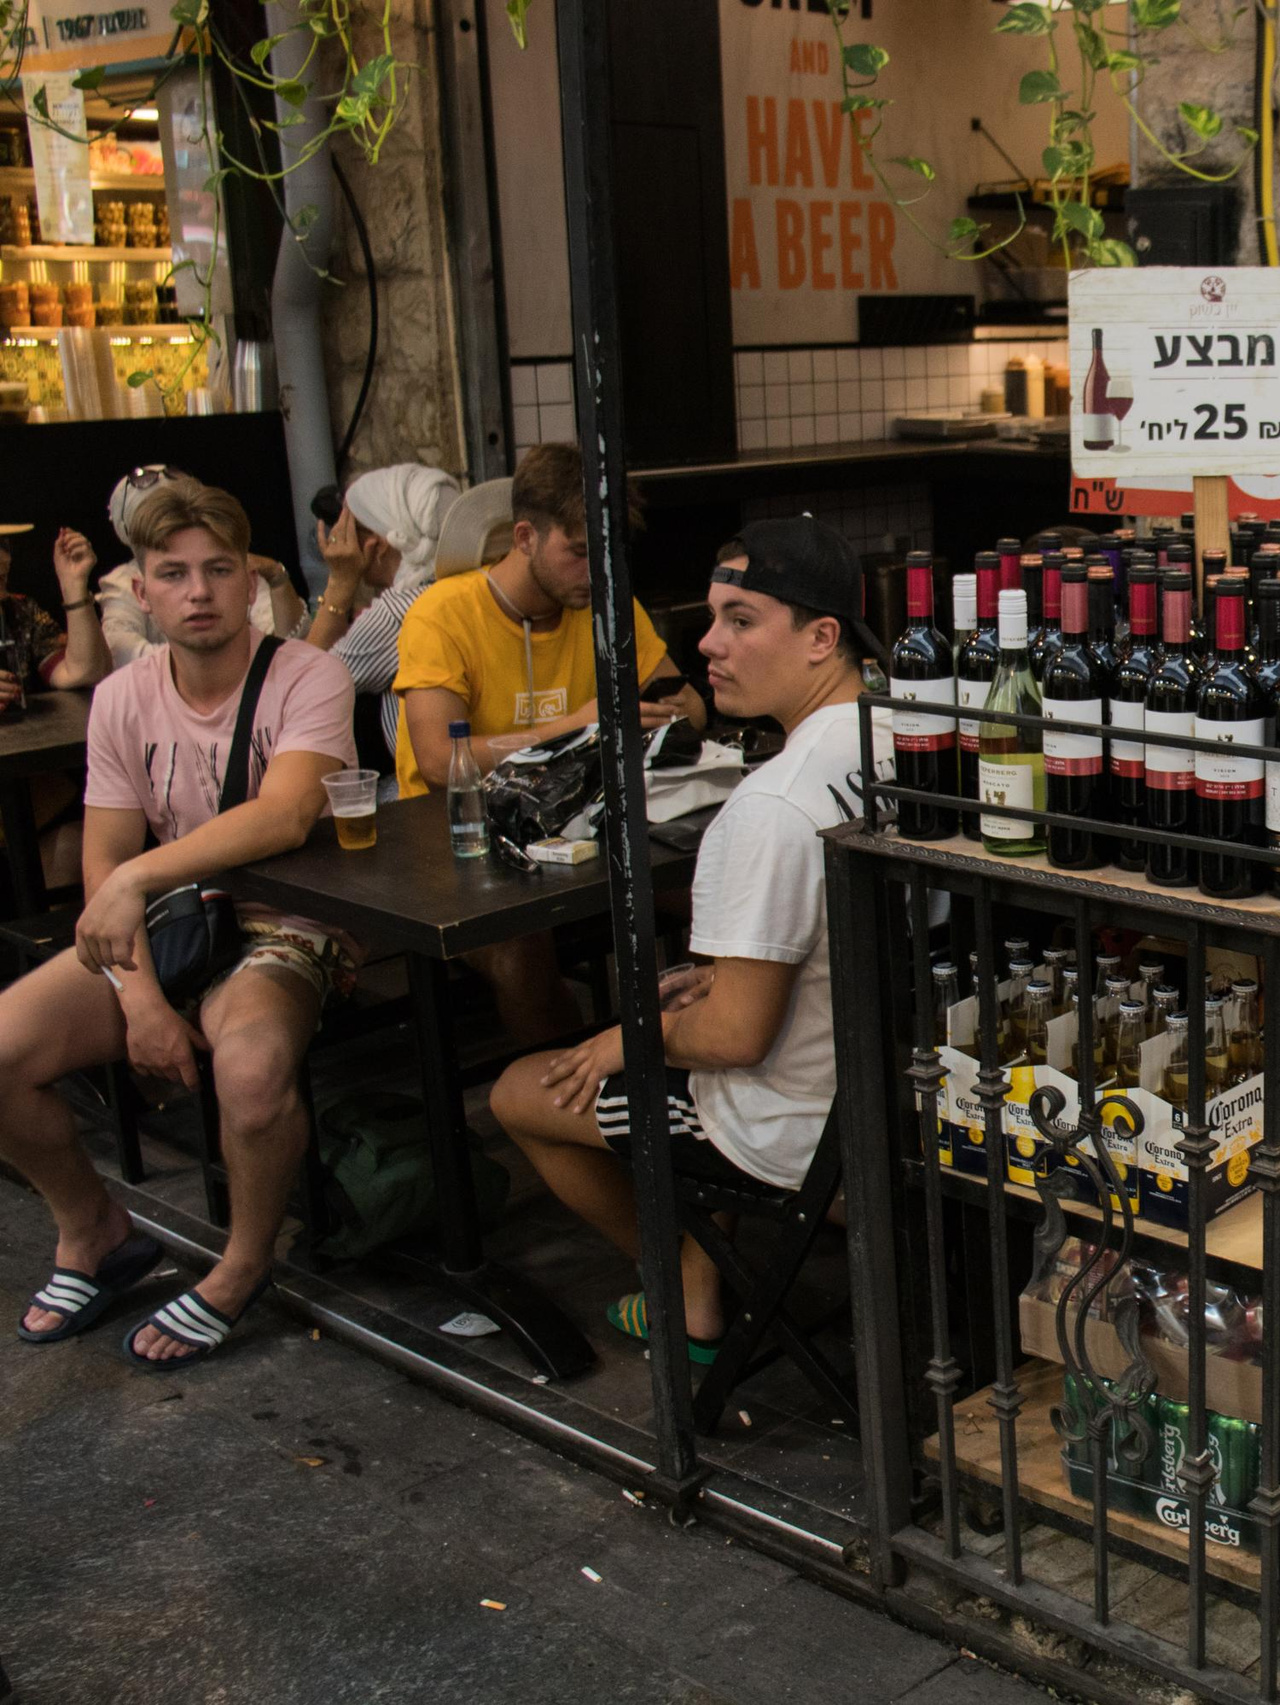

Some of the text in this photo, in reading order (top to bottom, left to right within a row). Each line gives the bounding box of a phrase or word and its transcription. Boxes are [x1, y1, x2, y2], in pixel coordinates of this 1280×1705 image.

[790, 38, 829, 75] AND
[746, 95, 874, 191] HAVE
[731, 197, 898, 291] A BEER
[1153, 334, 1275, 369] מבצע
[1193, 403, 1248, 441] 25
[1209, 1086, 1262, 1130] Corona
[1225, 1116, 1253, 1139] Extra
[1145, 1140, 1182, 1160] Corona
[1154, 1154, 1175, 1168] Extra
[1156, 1497, 1240, 1546] Carlerg
